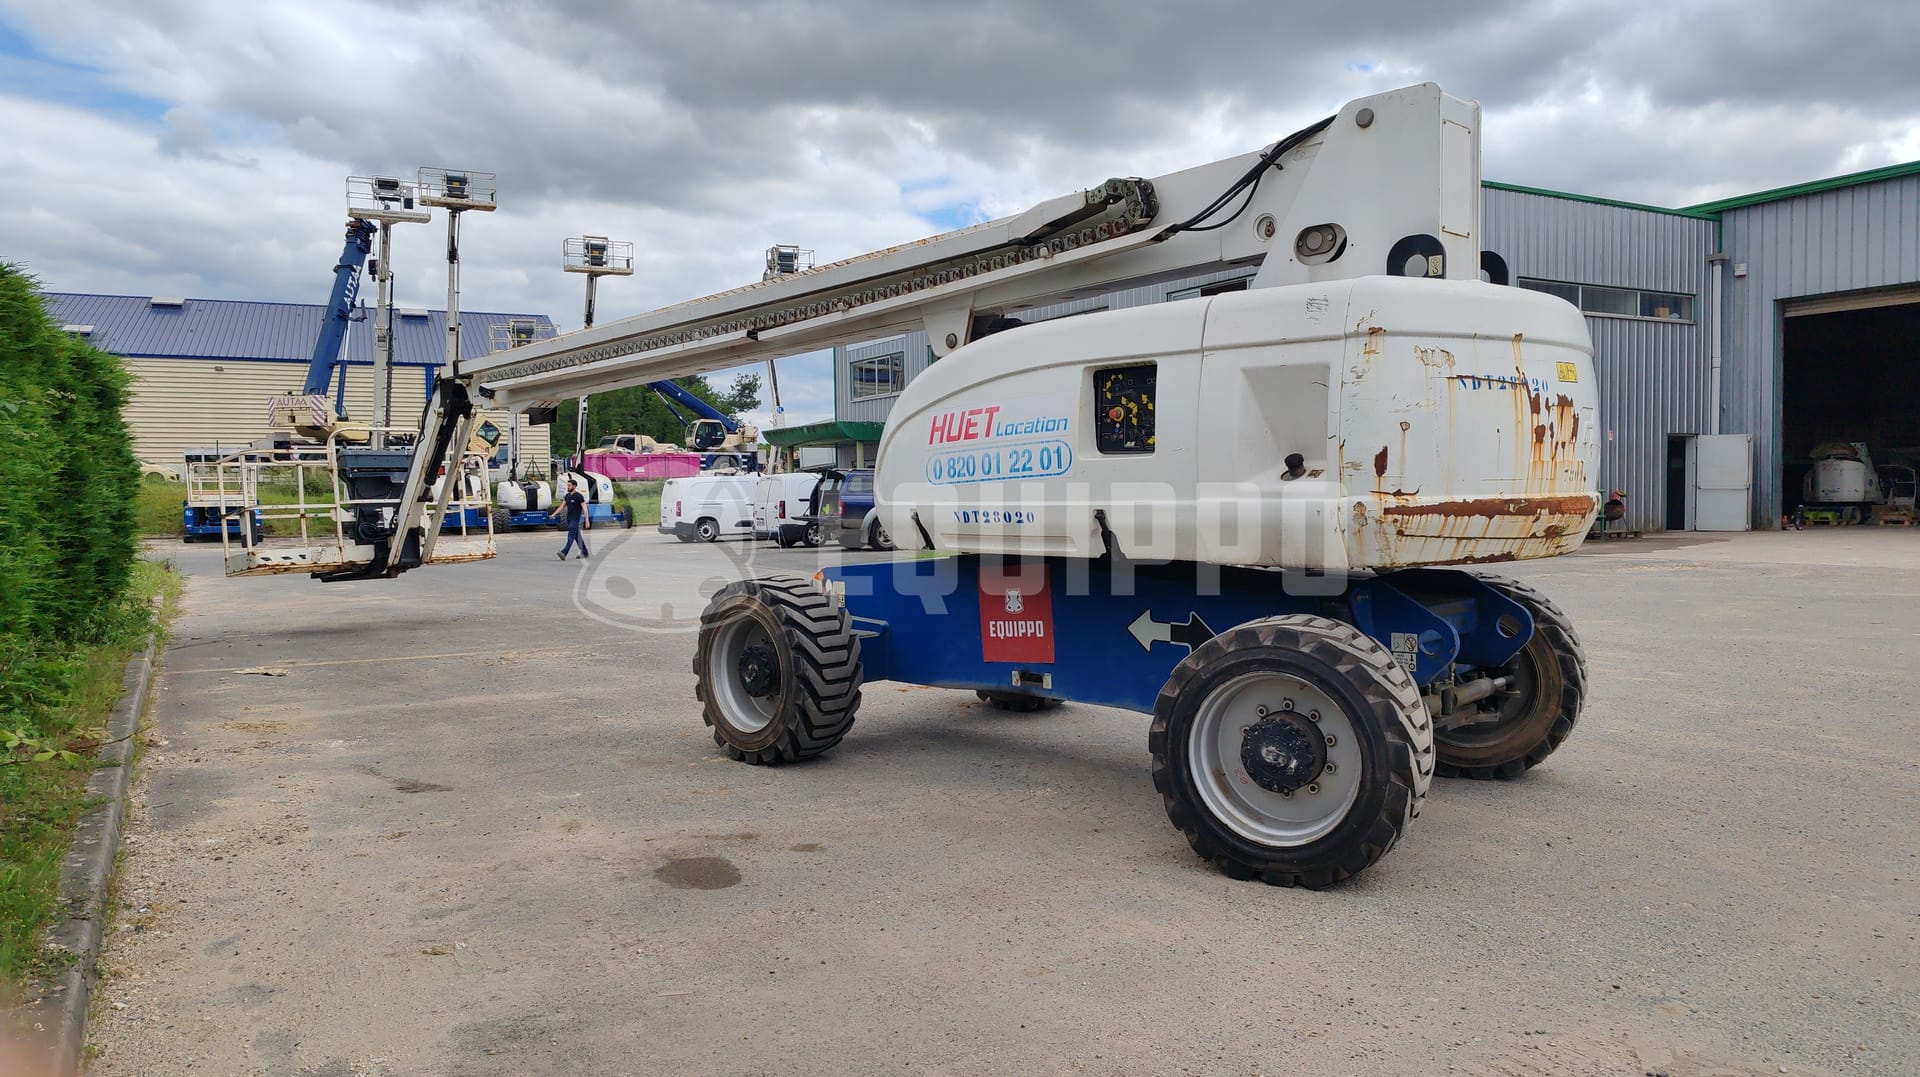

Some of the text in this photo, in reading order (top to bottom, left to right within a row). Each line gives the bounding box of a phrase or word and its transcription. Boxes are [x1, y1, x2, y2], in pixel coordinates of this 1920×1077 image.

[928, 405, 1069, 445] HUET Location
[933, 445, 1063, 480] 0 820 01 22 01
[954, 510, 1035, 525] NDT28020
[989, 620, 1044, 640] EQUIPPO
